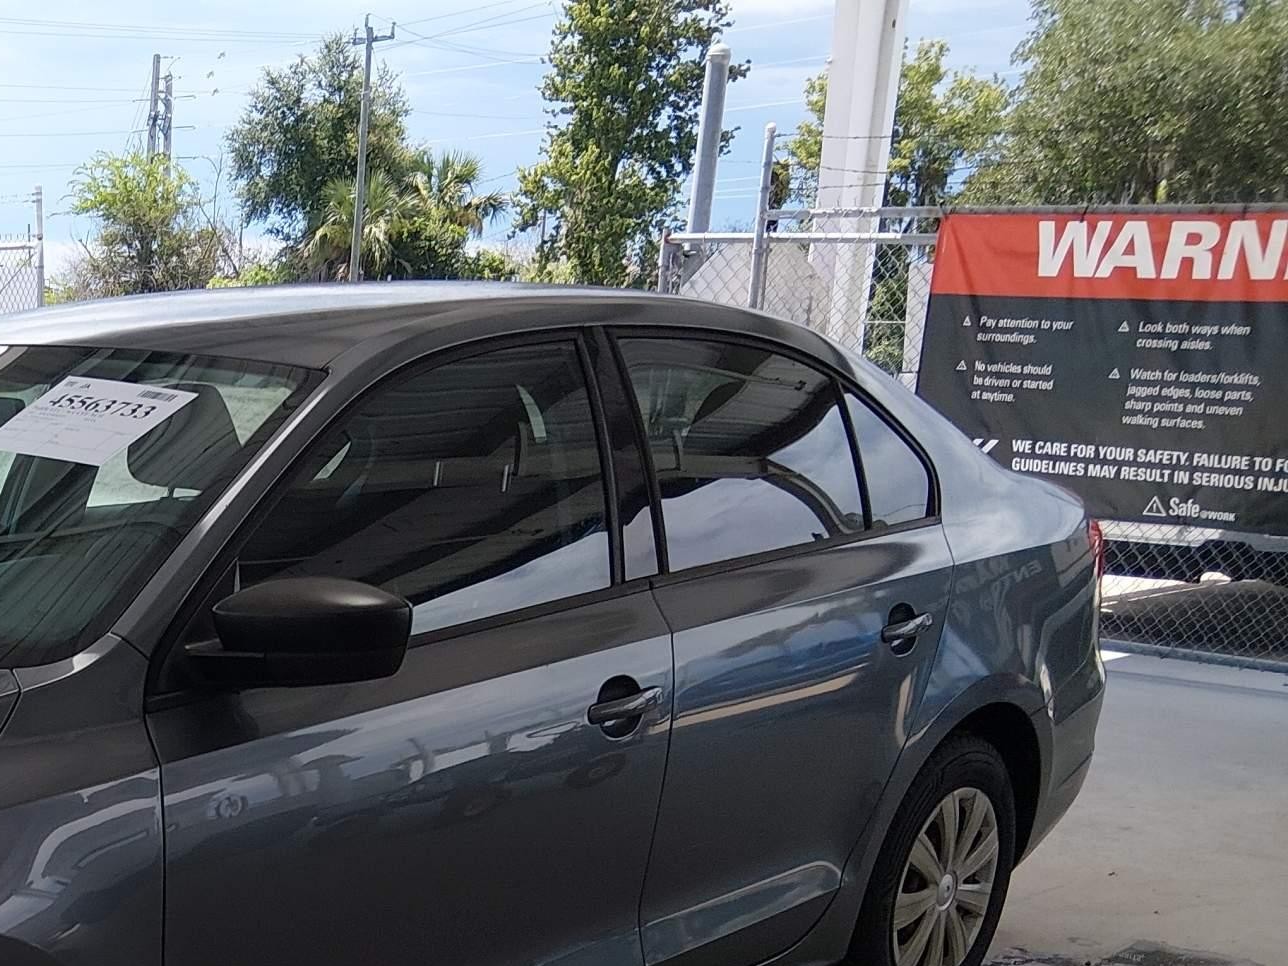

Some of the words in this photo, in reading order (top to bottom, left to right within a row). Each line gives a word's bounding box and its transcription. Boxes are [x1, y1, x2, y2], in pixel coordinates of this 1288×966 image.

[1038, 219, 1288, 280] WARN
[979, 315, 996, 328] Pay
[998, 317, 1039, 329] attention
[1040, 319, 1050, 329] to
[1052, 320, 1074, 332] your
[1138, 321, 1162, 333] Look
[1165, 322, 1189, 334] both
[1191, 325, 1219, 337] ways
[1221, 324, 1252, 336] when
[976, 332, 1037, 345] surroundings.
[1136, 337, 1179, 351] crossing
[1180, 339, 1213, 350] aisles.
[974, 360, 986, 372] No
[987, 362, 1022, 373] vehicles
[1023, 364, 1053, 376] should
[973, 375, 983, 386] be
[984, 376, 1010, 387] driven
[1012, 379, 1021, 388] or
[1023, 379, 1054, 390] started
[1130, 368, 1162, 381] Watch
[1164, 369, 1177, 381] for
[1179, 370, 1262, 387] loaders/forklifts,
[971, 390, 980, 399] at
[982, 390, 1015, 403] anytime.
[1127, 384, 1159, 398] jagged
[1161, 386, 1193, 400] edges,
[1194, 387, 1222, 399] loose
[1223, 390, 1254, 403] parts,
[49, 394, 157, 419] 45563733
[1124, 399, 1152, 413] sharp
[1153, 401, 1184, 413] points
[1185, 402, 1205, 414] and
[1206, 406, 1243, 416] uneven
[1122, 414, 1159, 429] walking
[1161, 416, 1206, 430] surfaces.
[1012, 439, 1032, 454] WE
[1035, 441, 1067, 456] CARE
[1070, 444, 1095, 459] FOR
[1099, 446, 1135, 462] YOUR
[1137, 449, 1190, 467] SAFETY.
[1192, 453, 1250, 470] FAILURE
[1253, 457, 1272, 472] TO
[1012, 458, 1085, 477] GUIDELINES
[1088, 463, 1118, 479] MAY
[1120, 466, 1172, 484] RESULT
[1174, 470, 1190, 485] IN
[1192, 472, 1254, 491] SERIOUS
